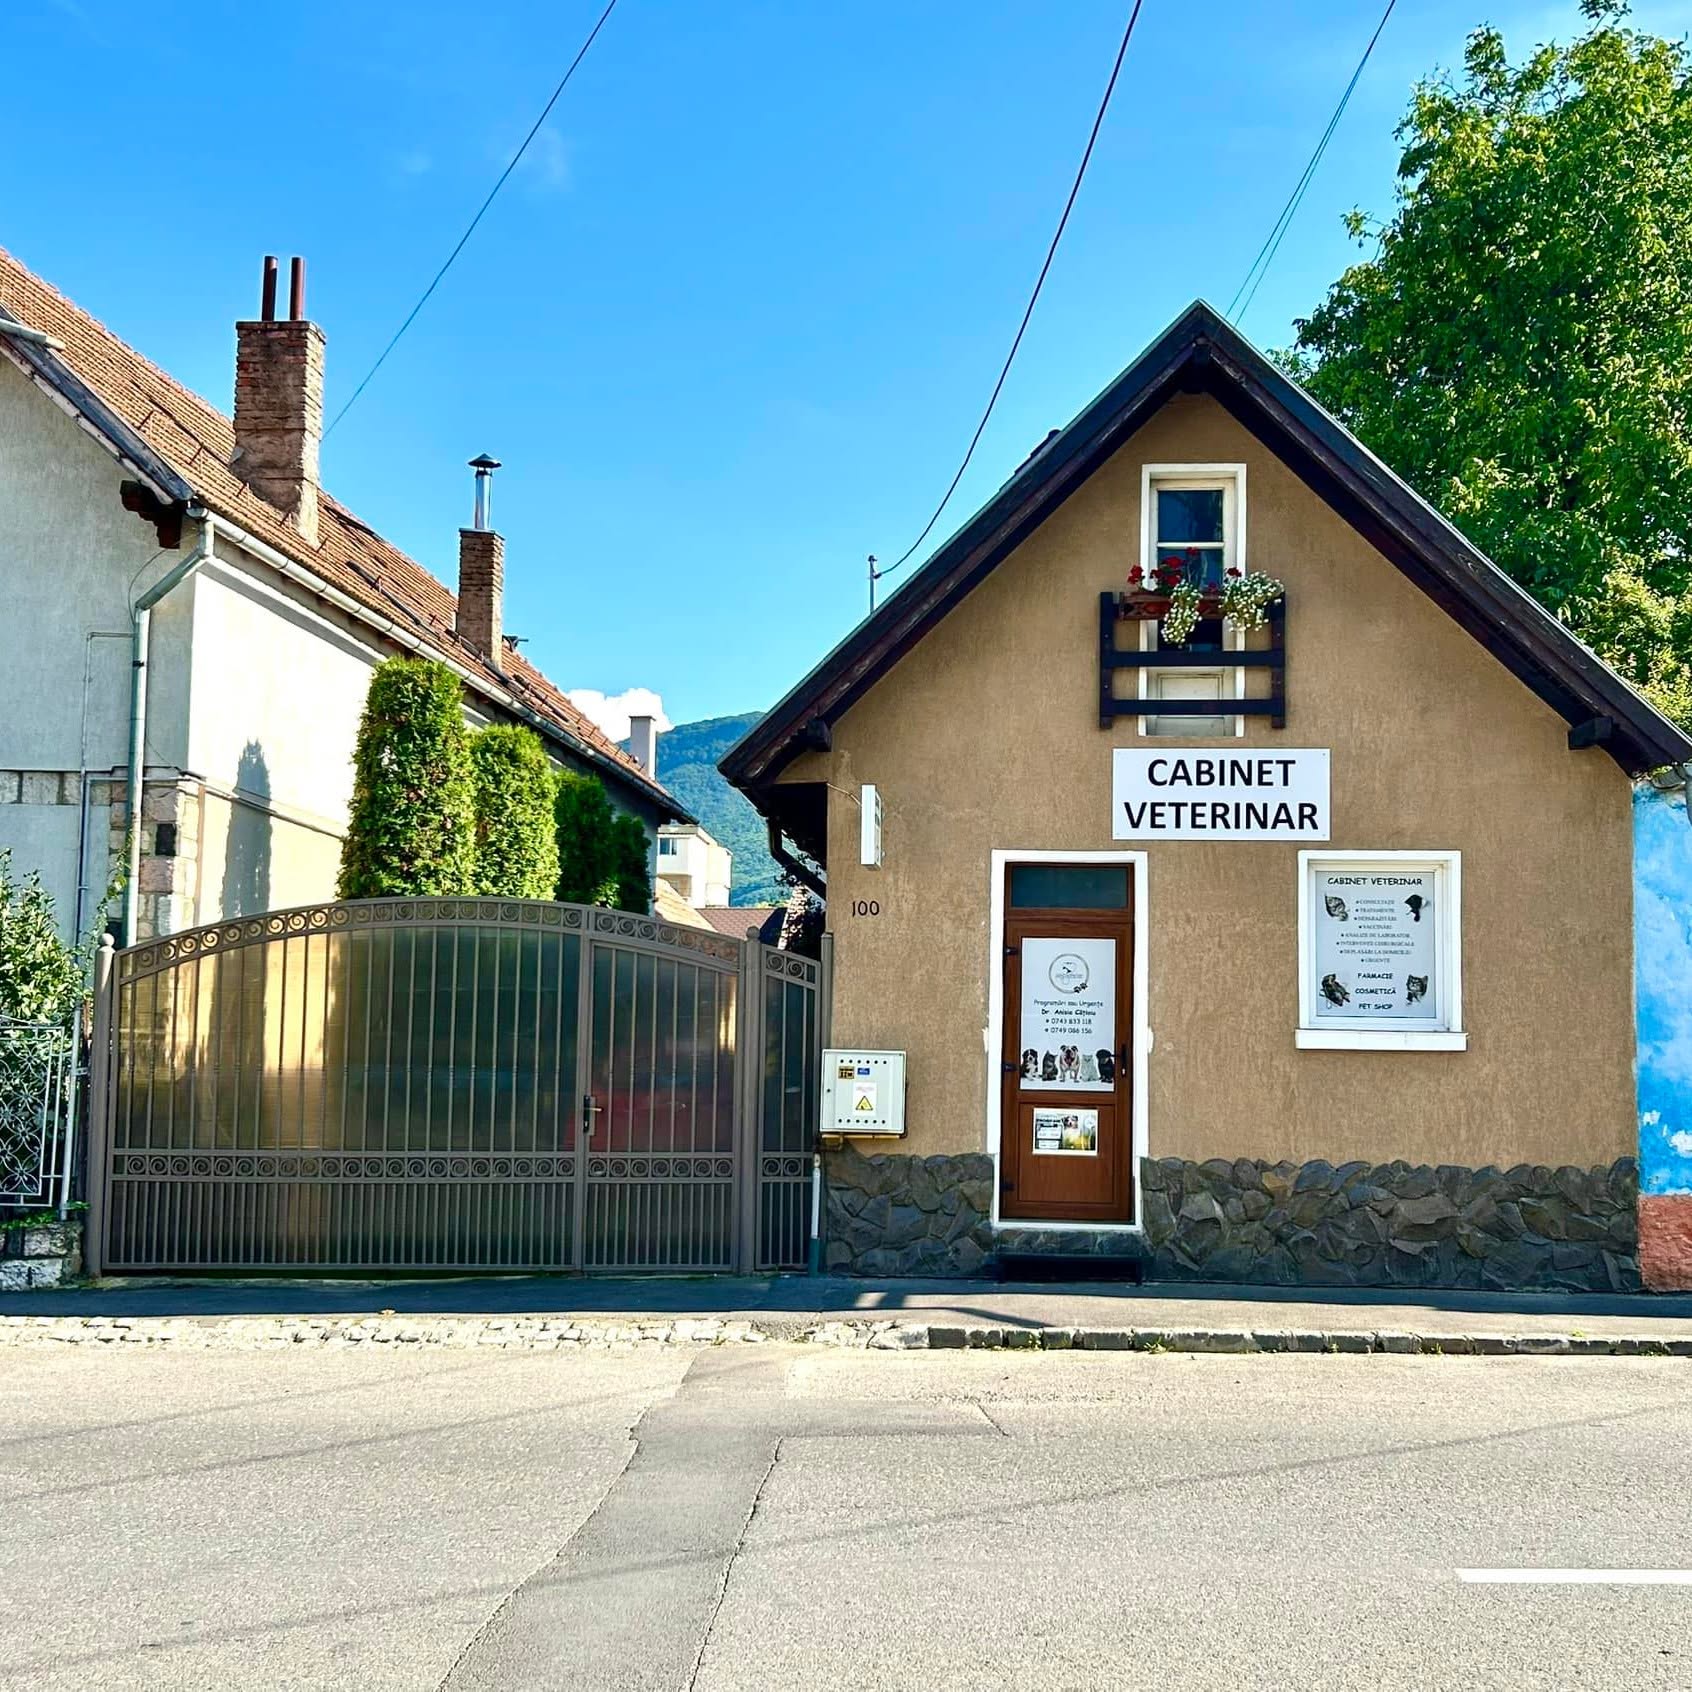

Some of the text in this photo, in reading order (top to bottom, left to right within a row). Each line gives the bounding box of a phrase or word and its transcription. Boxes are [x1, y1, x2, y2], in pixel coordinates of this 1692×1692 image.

[1148, 758, 1296, 787] CABINET
[1123, 801, 1319, 830] VETERINAR
[1327, 877, 1423, 886] CABINET VETERINAR
[852, 900, 880, 917] 100
[1355, 987, 1396, 995] COSMETICĂ
